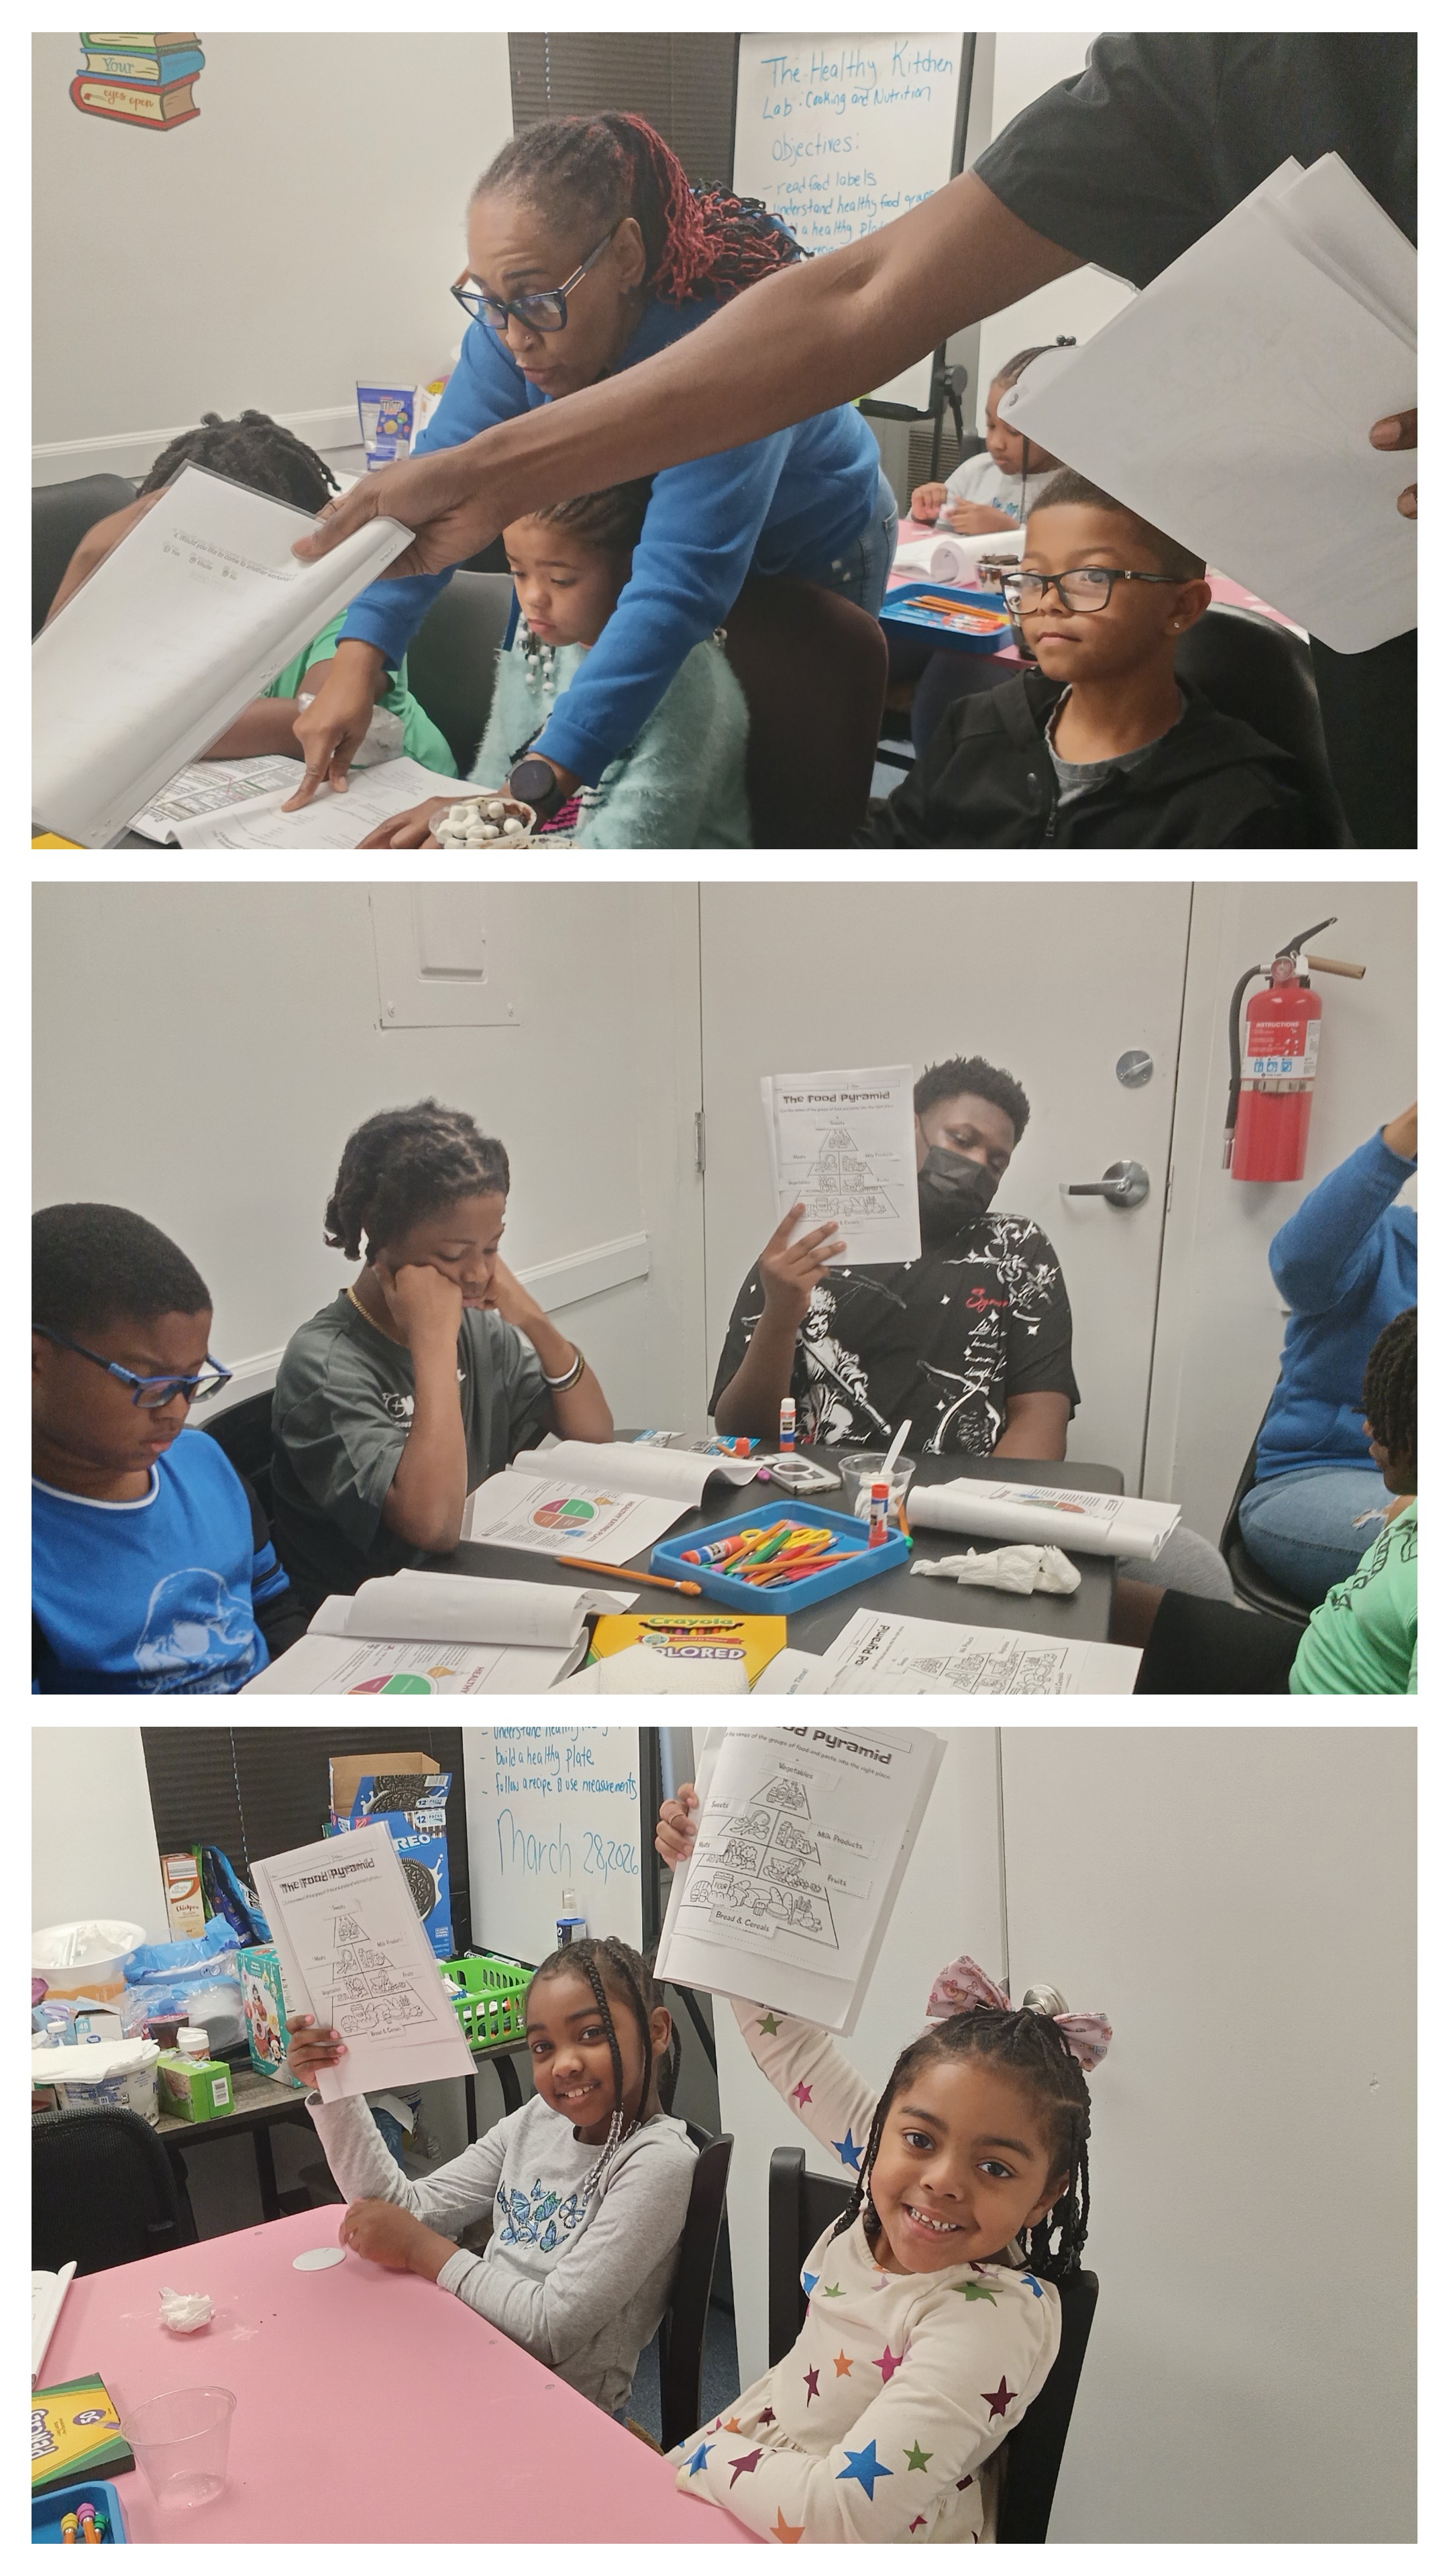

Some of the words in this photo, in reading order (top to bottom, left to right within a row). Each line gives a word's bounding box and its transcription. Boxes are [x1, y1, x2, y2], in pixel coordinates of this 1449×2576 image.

[102, 57, 135, 74] Your
[761, 56, 801, 88] The
[810, 49, 877, 89] Healthy
[892, 40, 953, 77] Kitchen
[104, 89, 126, 105] eyes
[129, 97, 154, 111] open
[806, 90, 846, 115] Cooking
[852, 88, 869, 106] and
[874, 85, 931, 105] Nutrition
[772, 132, 859, 167] Objectives:
[777, 178, 806, 195] read
[808, 175, 829, 191] food
[837, 169, 877, 187] labels
[838, 193, 877, 217] healthy
[880, 192, 900, 209] food
[812, 219, 852, 244] healthy
[179, 535, 197, 546] Would
[196, 543, 207, 551] you
[207, 546, 217, 555] like
[224, 555, 239, 564] come
[783, 1095, 804, 1104] The
[808, 1094, 837, 1103] Food
[841, 1091, 890, 1103] Pyramid
[614, 1501, 635, 1519] HEALTHY
[649, 1617, 734, 1625] Crayola
[653, 1646, 745, 1660] LORED
[855, 1656, 869, 1665] od
[862, 1625, 890, 1654] Pyramid
[460, 1666, 484, 1693] HEALTHY
[794, 1668, 809, 1683] Time!
[768, 1737, 787, 1746] groups
[796, 1745, 809, 1753] food
[820, 1754, 837, 1762] paste
[839, 1758, 849, 1766] into
[850, 1762, 859, 1770] the
[861, 1766, 875, 1774] right
[812, 1729, 892, 1765] Pyramid
[496, 1746, 515, 1766] build
[519, 1753, 524, 1763] a
[527, 1744, 560, 1776] healthy
[566, 1744, 594, 1773] plate
[779, 1762, 814, 1779] Vegetables
[496, 1772, 519, 1796] follow
[523, 1778, 528, 1790] a
[529, 1774, 552, 1798] recipe
[566, 1778, 578, 1791] use
[582, 1772, 637, 1800] measurements
[711, 1801, 729, 1809] Sweets
[417, 1815, 426, 1823] 12
[393, 1834, 431, 1851] REO
[497, 1809, 571, 1878] March
[816, 1829, 831, 1841] Milk
[833, 1834, 863, 1850] Products
[279, 1880, 299, 1894] The
[300, 1872, 329, 1888] Food
[329, 1858, 375, 1879] Pyramid
[827, 1874, 847, 1887] Fruits
[715, 1911, 735, 1923] Bread
[745, 1919, 770, 1932] Cereals
[321, 1987, 341, 1996] Vegetables
[80, 2411, 100, 2424] 50
